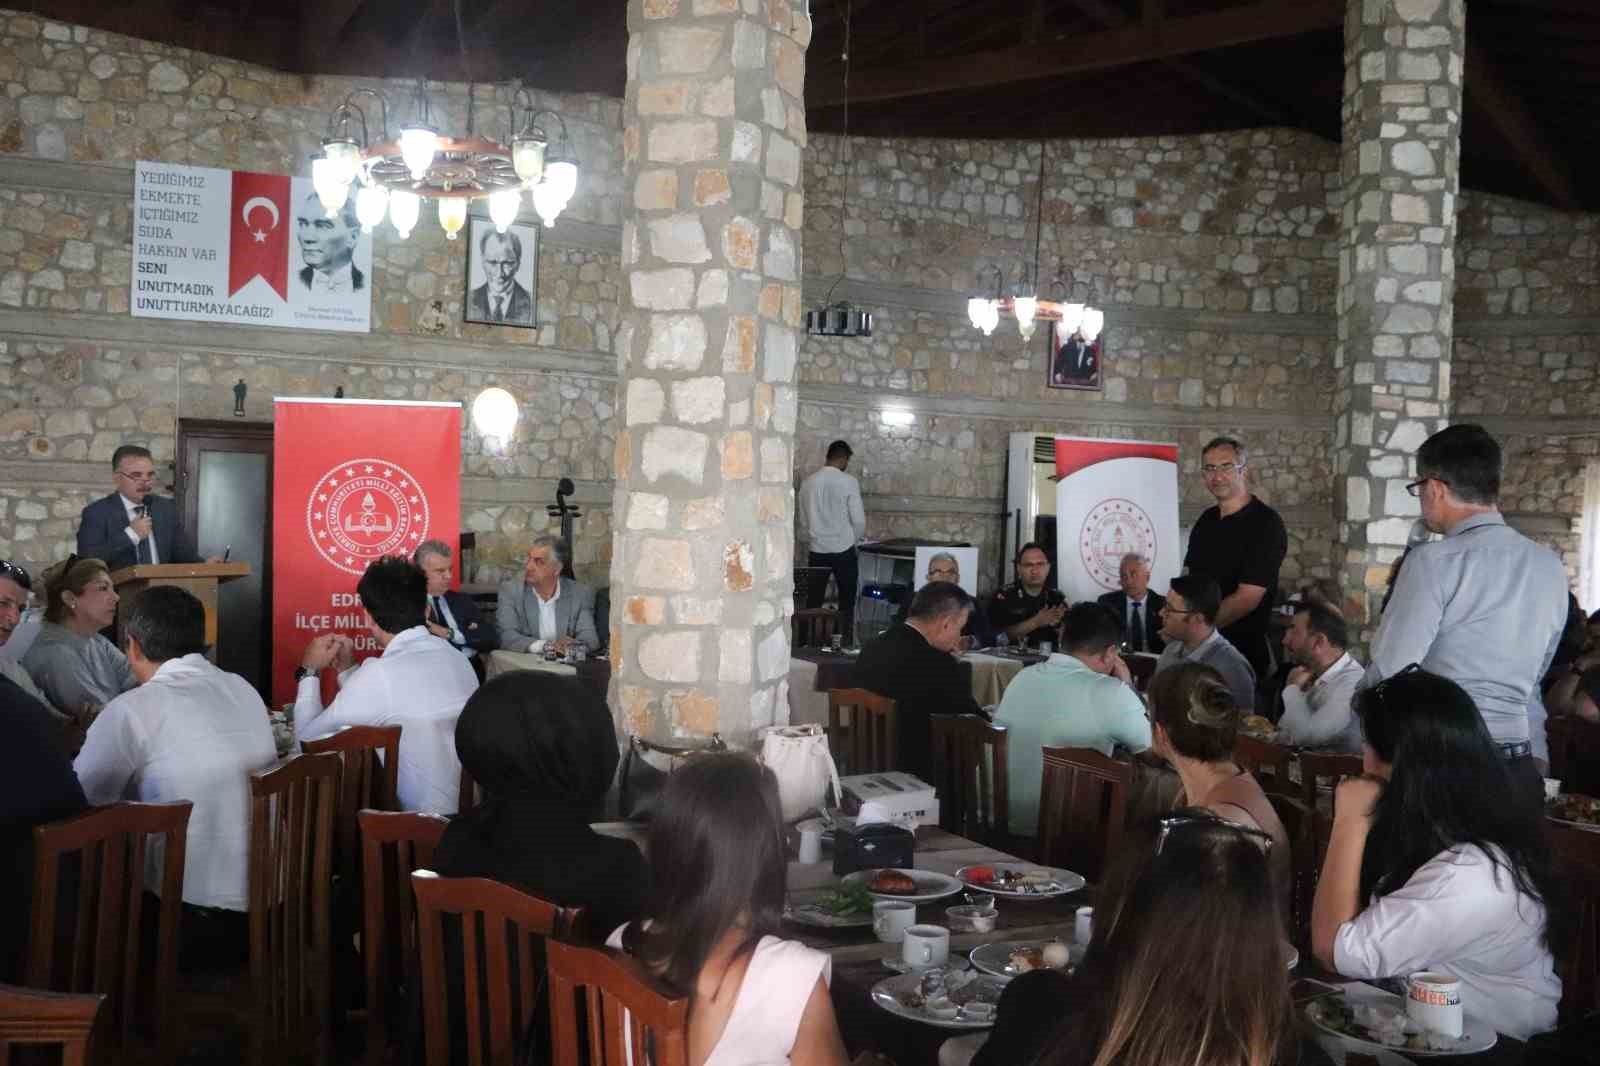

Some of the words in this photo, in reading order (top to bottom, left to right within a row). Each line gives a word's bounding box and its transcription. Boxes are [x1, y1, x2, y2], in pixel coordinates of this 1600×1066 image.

[138, 225, 173, 239] SUDA
[138, 243, 187, 260] HAKKIN
[137, 279, 215, 296] UNUTMADIK
[331, 592, 363, 607] EDR
[295, 612, 329, 633] İLÇE
[334, 612, 369, 629] MİLL
